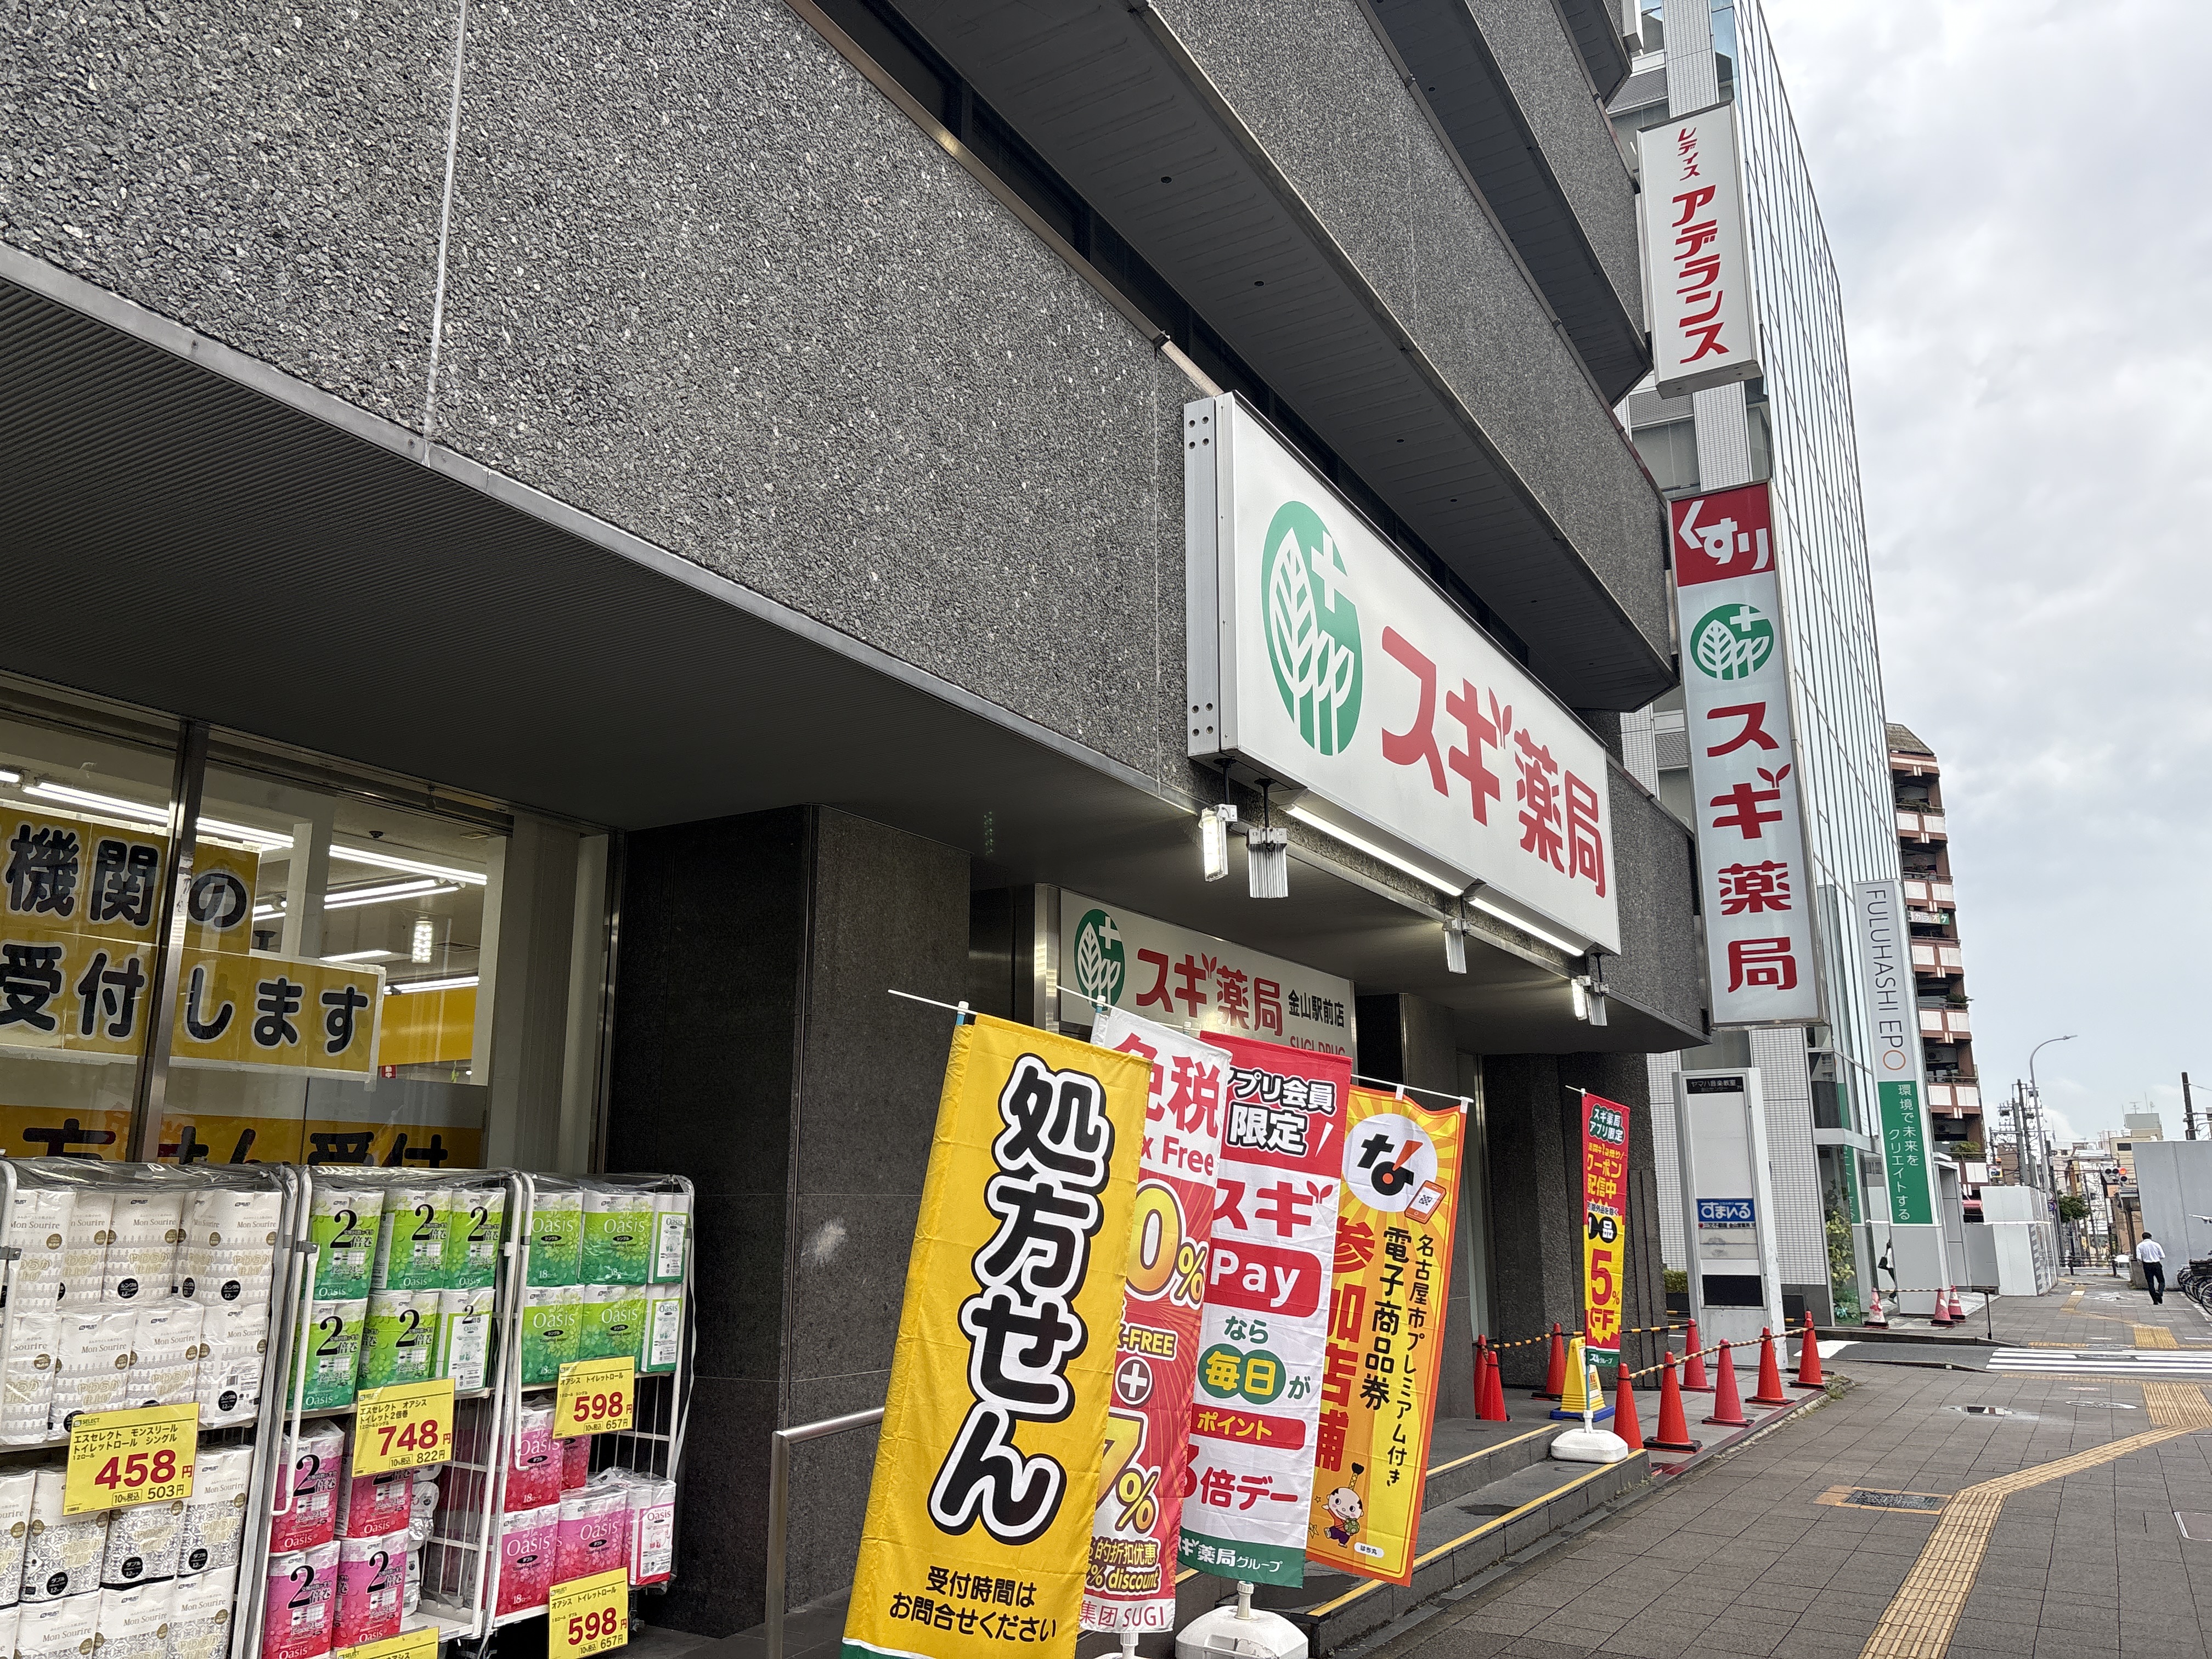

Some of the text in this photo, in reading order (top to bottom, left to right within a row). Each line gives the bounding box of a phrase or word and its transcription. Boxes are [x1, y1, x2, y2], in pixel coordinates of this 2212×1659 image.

[1672, 127, 1730, 364] レディス アデランス
[1678, 500, 1768, 570] くすり
[1381, 626, 1606, 898] スギ薬局
[1707, 701, 1798, 992] スギ薬局
[1914, 913, 1947, 923] カラオケ
[1866, 889, 1906, 1071] FULUHASHI EPO
[0, 944, 369, 1053] 受付します
[1136, 948, 1283, 1036] スギ薬局
[1288, 989, 1344, 1028] 金山駅前店
[1594, 1109, 1621, 1127] スギ薬局
[1898, 1084, 1918, 1166] 環境で未来を
[1231, 1108, 1307, 1154] 限定
[1589, 1121, 1623, 1142] アプリ限定
[1162, 1135, 1214, 1176] Free
[1587, 1153, 1622, 1178] クーポン
[1889, 1129, 1910, 1220] クリエイトする
[1588, 1172, 1616, 1199] 配信中
[1213, 1178, 1333, 1238] スギ
[1701, 1202, 1751, 1219] すまいる
[532, 1217, 574, 1233] Oasis
[605, 1218, 645, 1233] Oasis
[404, 1278, 427, 1286] Oasis
[1210, 1248, 1300, 1308] Pay
[319, 1287, 346, 1296] Oasis
[933, 1059, 1109, 1535] 処方せん
[602, 1308, 638, 1324] Oasis
[659, 1304, 678, 1312] Oasis
[1359, 1226, 1412, 1410] 電子商品券
[533, 1311, 575, 1328] Oasis
[1224, 1316, 1268, 1344] なら
[1386, 1234, 1435, 1487] 名古屋市プレミアム付き
[586, 1373, 623, 1383] トイレットロール
[306, 1395, 332, 1406] Oasis
[360, 1400, 427, 1415] エスセレクト オアシス
[360, 1410, 408, 1424] トイレット2倍巻
[606, 1419, 628, 1430] 657円
[1197, 1412, 1272, 1440] ポイント
[74, 1424, 178, 1443] エスセレクト モンスリール
[74, 1434, 177, 1454] トイレットロール シングル
[417, 1450, 445, 1463] 822円
[520, 1438, 560, 1456] Oasis
[148, 1485, 184, 1499] 503円
[647, 1511, 671, 1520] Oasis
[364, 1521, 390, 1534] Oasis
[580, 1521, 618, 1541] Oasis
[284, 1535, 312, 1548] Oasis
[507, 1533, 550, 1556] Oasis
[926, 1566, 1036, 1607] 受付時間は
[1108, 1568, 1159, 1590] discount
[552, 1587, 616, 1609] オアシス トイレットロール
[889, 1592, 1056, 1642] お問合せください
[1122, 1606, 1164, 1627] SUGI
[359, 1629, 383, 1643] Oasis
[601, 1634, 623, 1649] 657円
